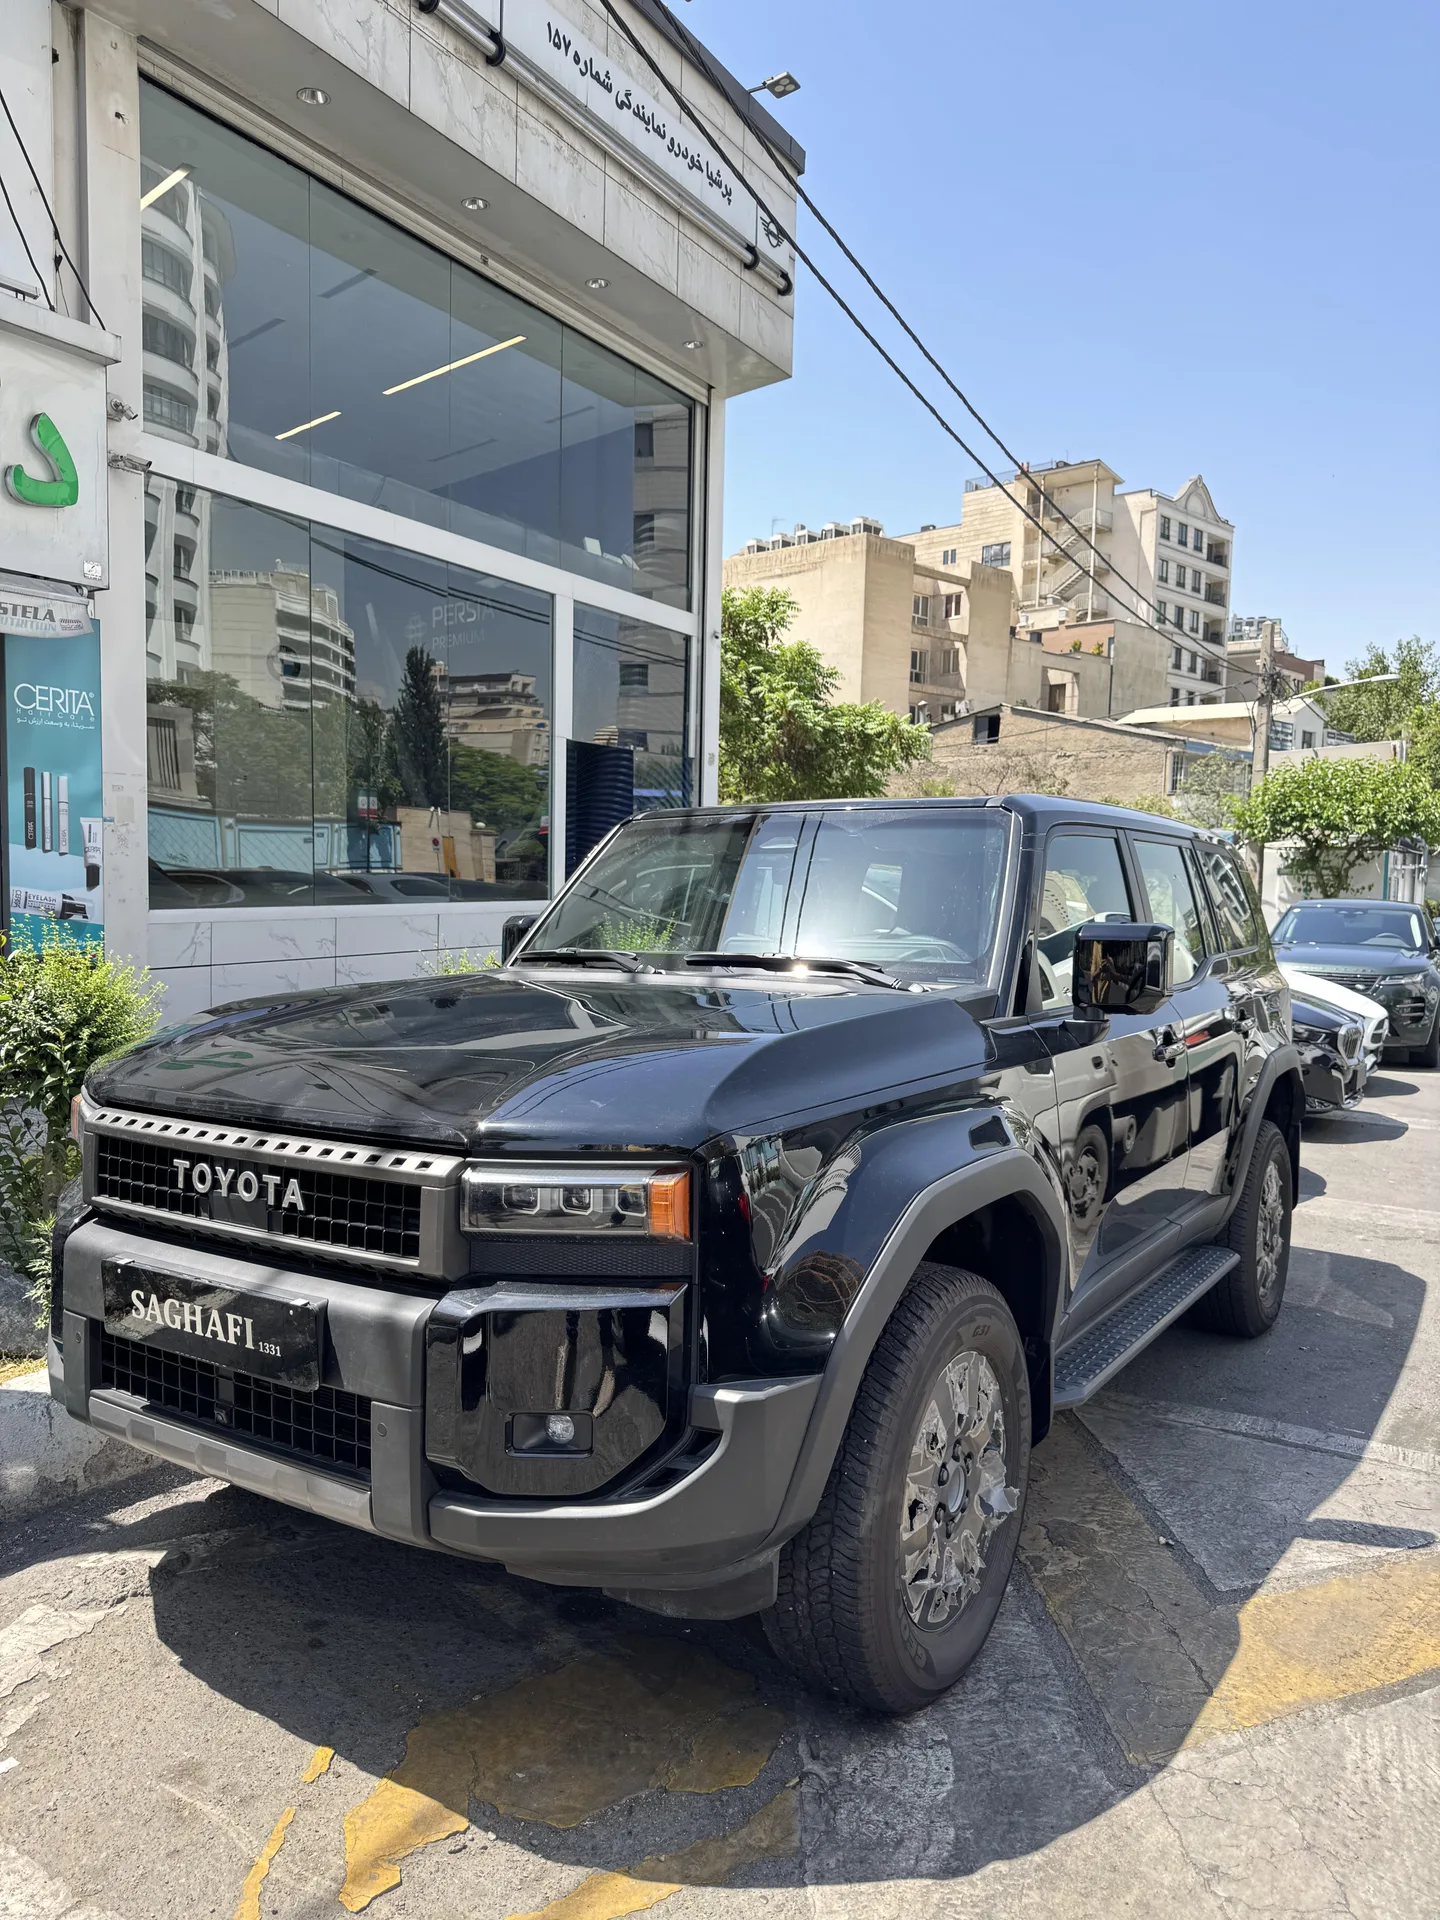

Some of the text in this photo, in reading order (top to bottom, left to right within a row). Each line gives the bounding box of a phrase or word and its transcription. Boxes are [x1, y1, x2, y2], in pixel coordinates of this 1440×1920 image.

[547, 21, 732, 205] پرشیا خودرو نمایندگی شماره ۱۵۷
[432, 629, 485, 651] PREMIUM
[28, 893, 57, 904] EYELASH
[172, 1158, 306, 1212] TOYOTA
[130, 1288, 282, 1357] SAGHAFI 1331
